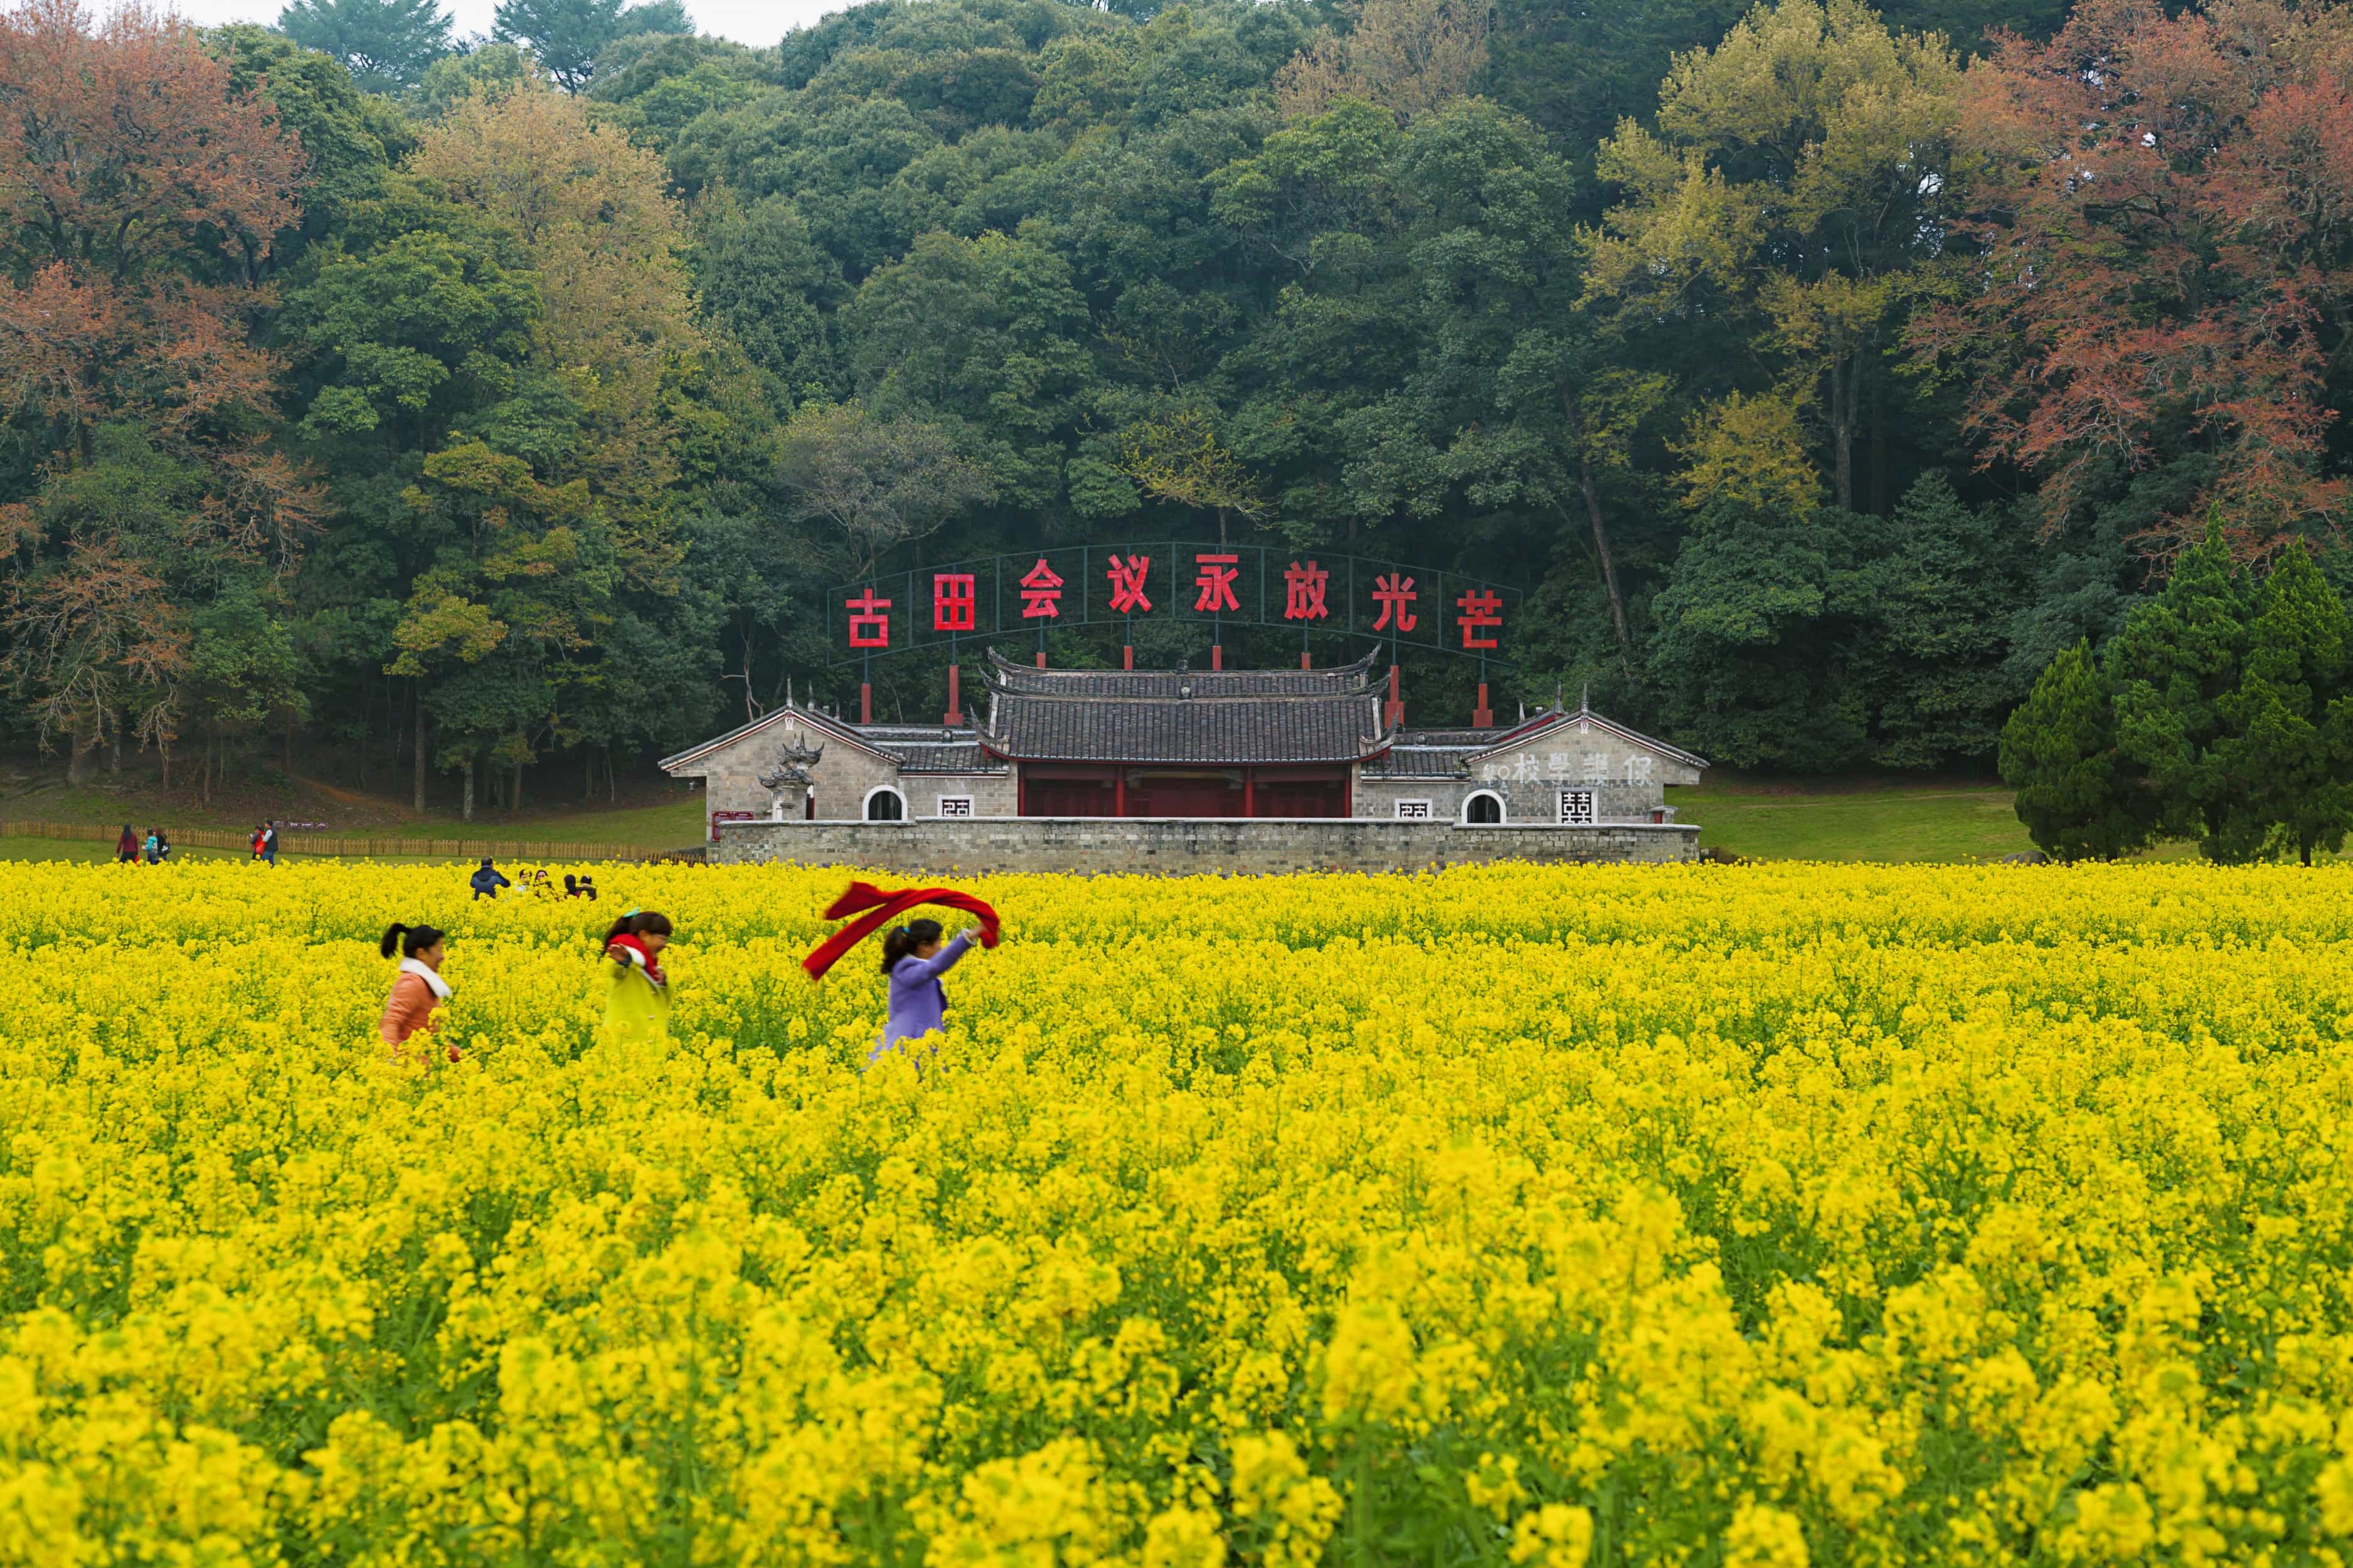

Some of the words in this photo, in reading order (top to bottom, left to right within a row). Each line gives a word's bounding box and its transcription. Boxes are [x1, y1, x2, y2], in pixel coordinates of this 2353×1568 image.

[846, 554, 1502, 649] 古田会议永放光芒
